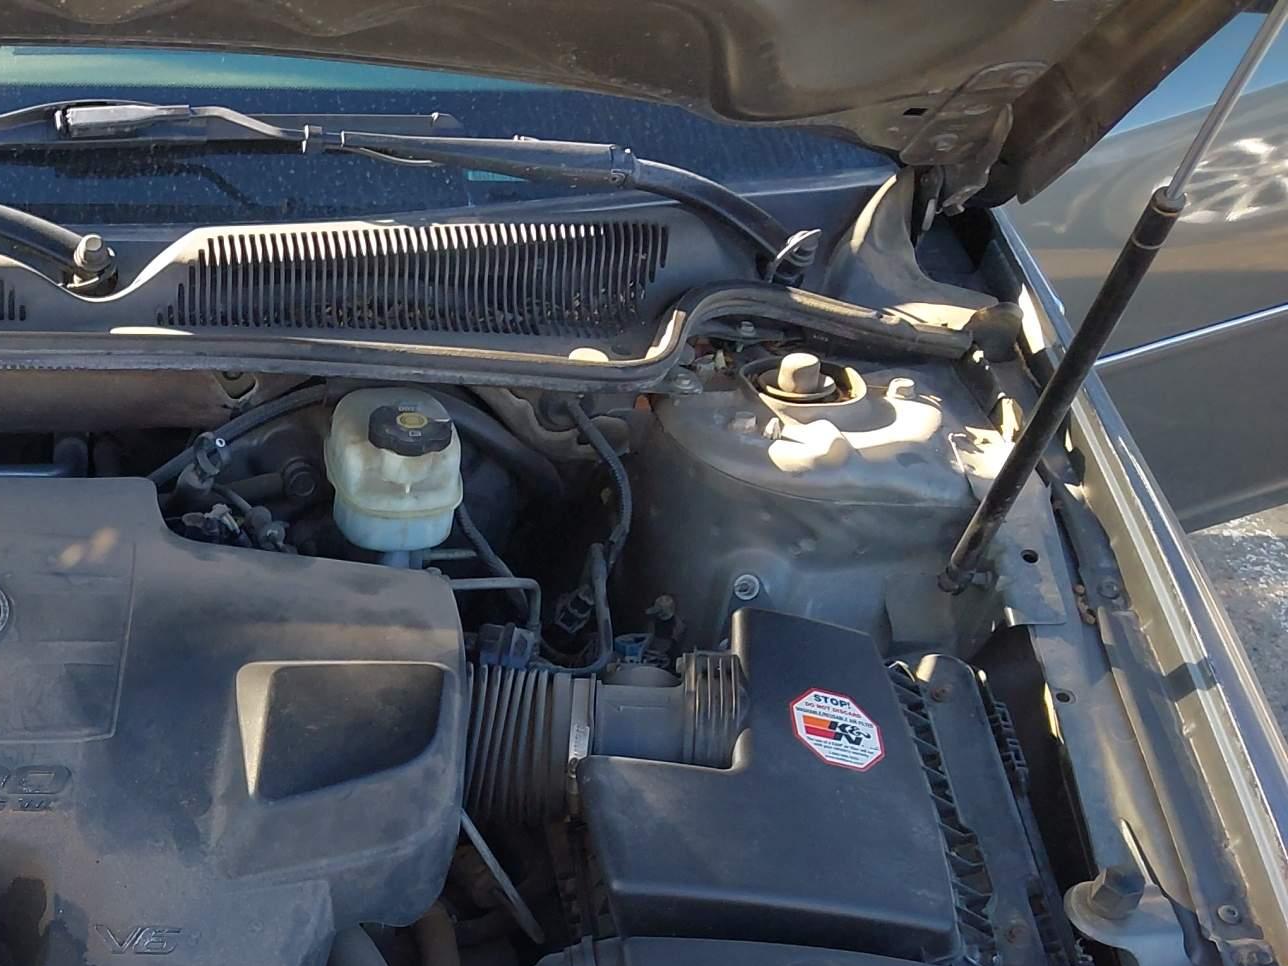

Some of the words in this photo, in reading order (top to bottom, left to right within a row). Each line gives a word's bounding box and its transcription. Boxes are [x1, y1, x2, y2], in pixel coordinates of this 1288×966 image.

[814, 694, 851, 709] STOP!
[832, 706, 862, 719] DISCARD
[94, 923, 182, 955] V6
